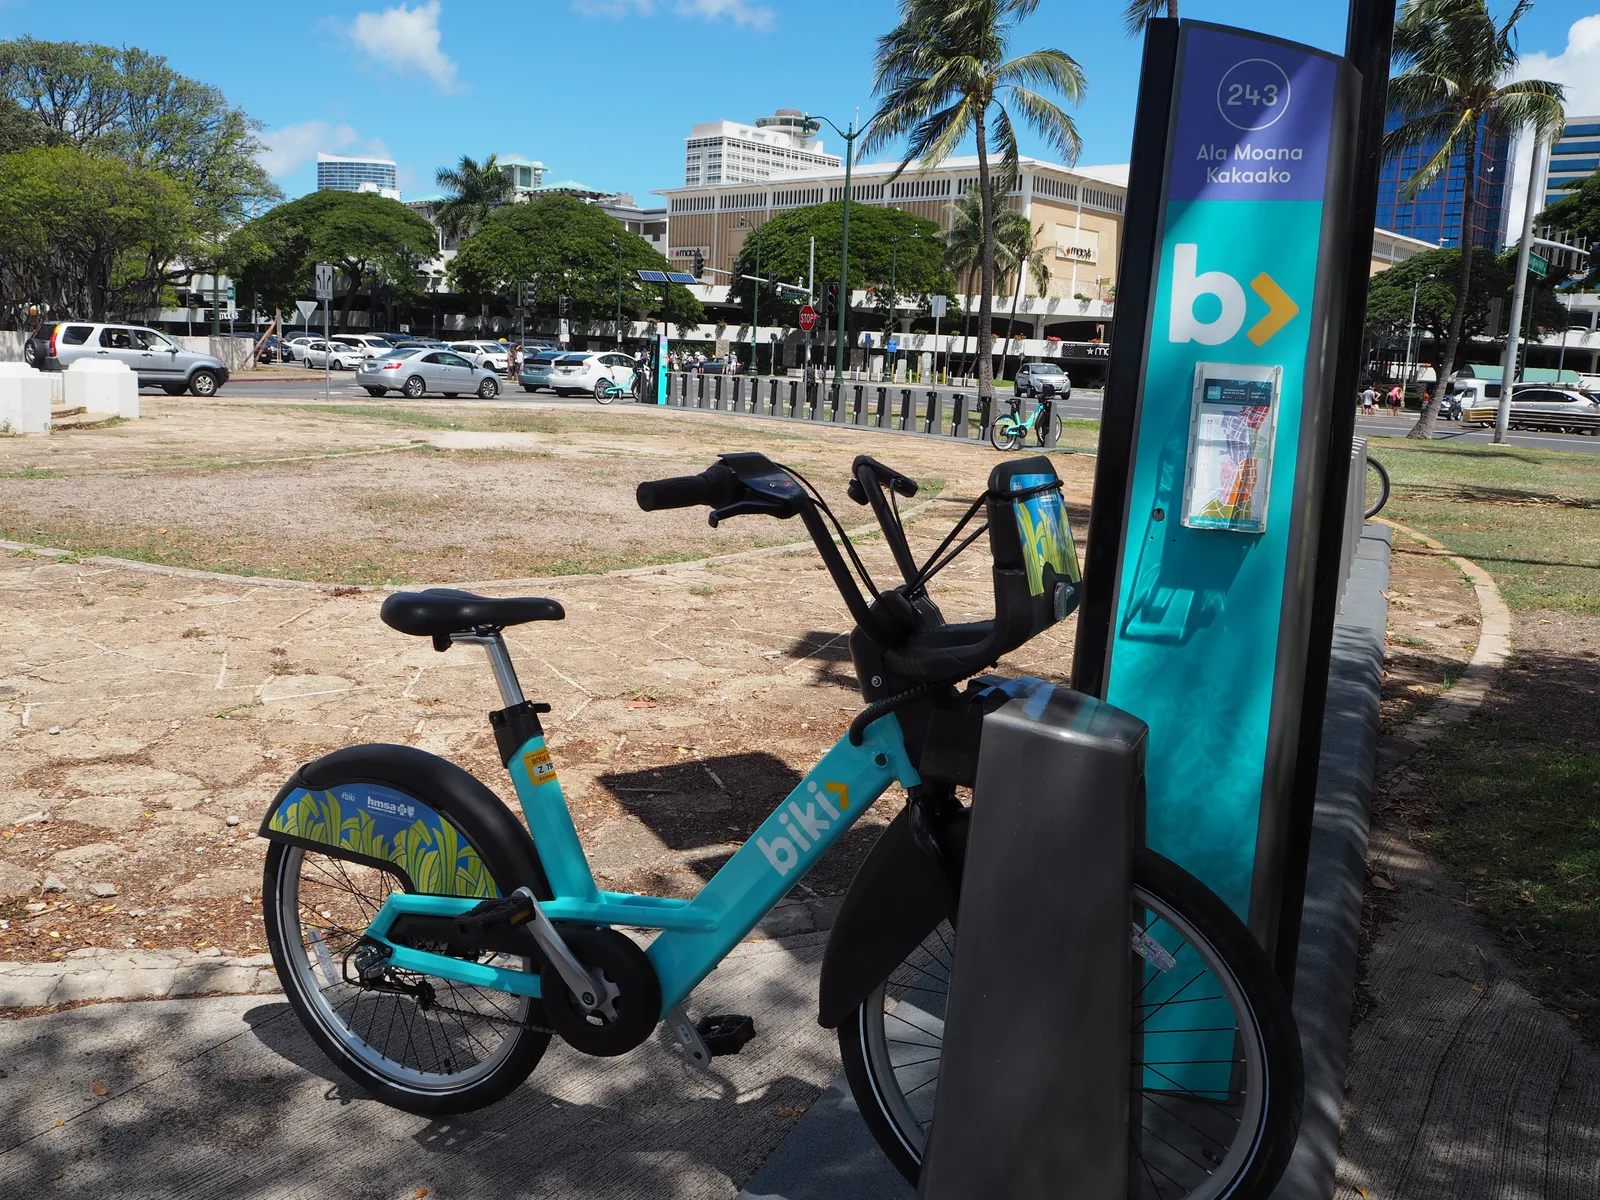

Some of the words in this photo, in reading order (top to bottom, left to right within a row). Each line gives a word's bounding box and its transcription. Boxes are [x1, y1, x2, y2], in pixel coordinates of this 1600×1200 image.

[1226, 83, 1279, 107] 243
[1196, 143, 1228, 161] Ala
[1233, 144, 1303, 161] Moana
[1205, 166, 1292, 184] Kakaako
[800, 313, 814, 323] STOP
[537, 765, 545, 774] Z
[340, 791, 356, 803] #biki
[367, 795, 397, 812] hmsa
[755, 780, 842, 877] biki
